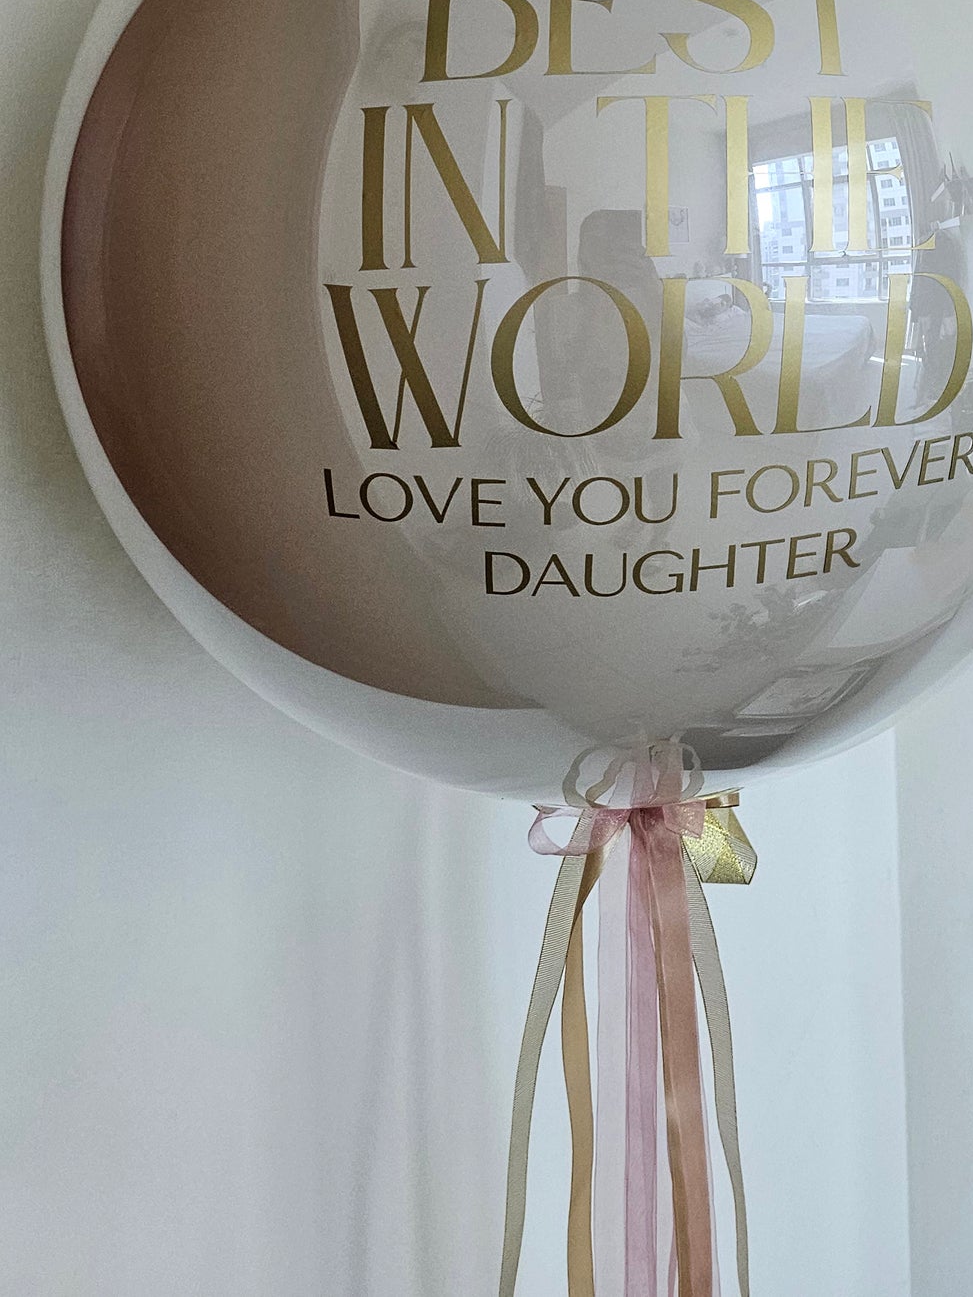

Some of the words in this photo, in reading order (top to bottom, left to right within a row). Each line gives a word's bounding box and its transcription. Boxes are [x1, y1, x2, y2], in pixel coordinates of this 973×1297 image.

[359, 99, 512, 271] IN
[596, 94, 936, 257] THE
[323, 273, 973, 450] WORLD
[324, 468, 506, 527] LOVE
[526, 472, 678, 526] YOU
[484, 528, 860, 597] DAUGHTER
